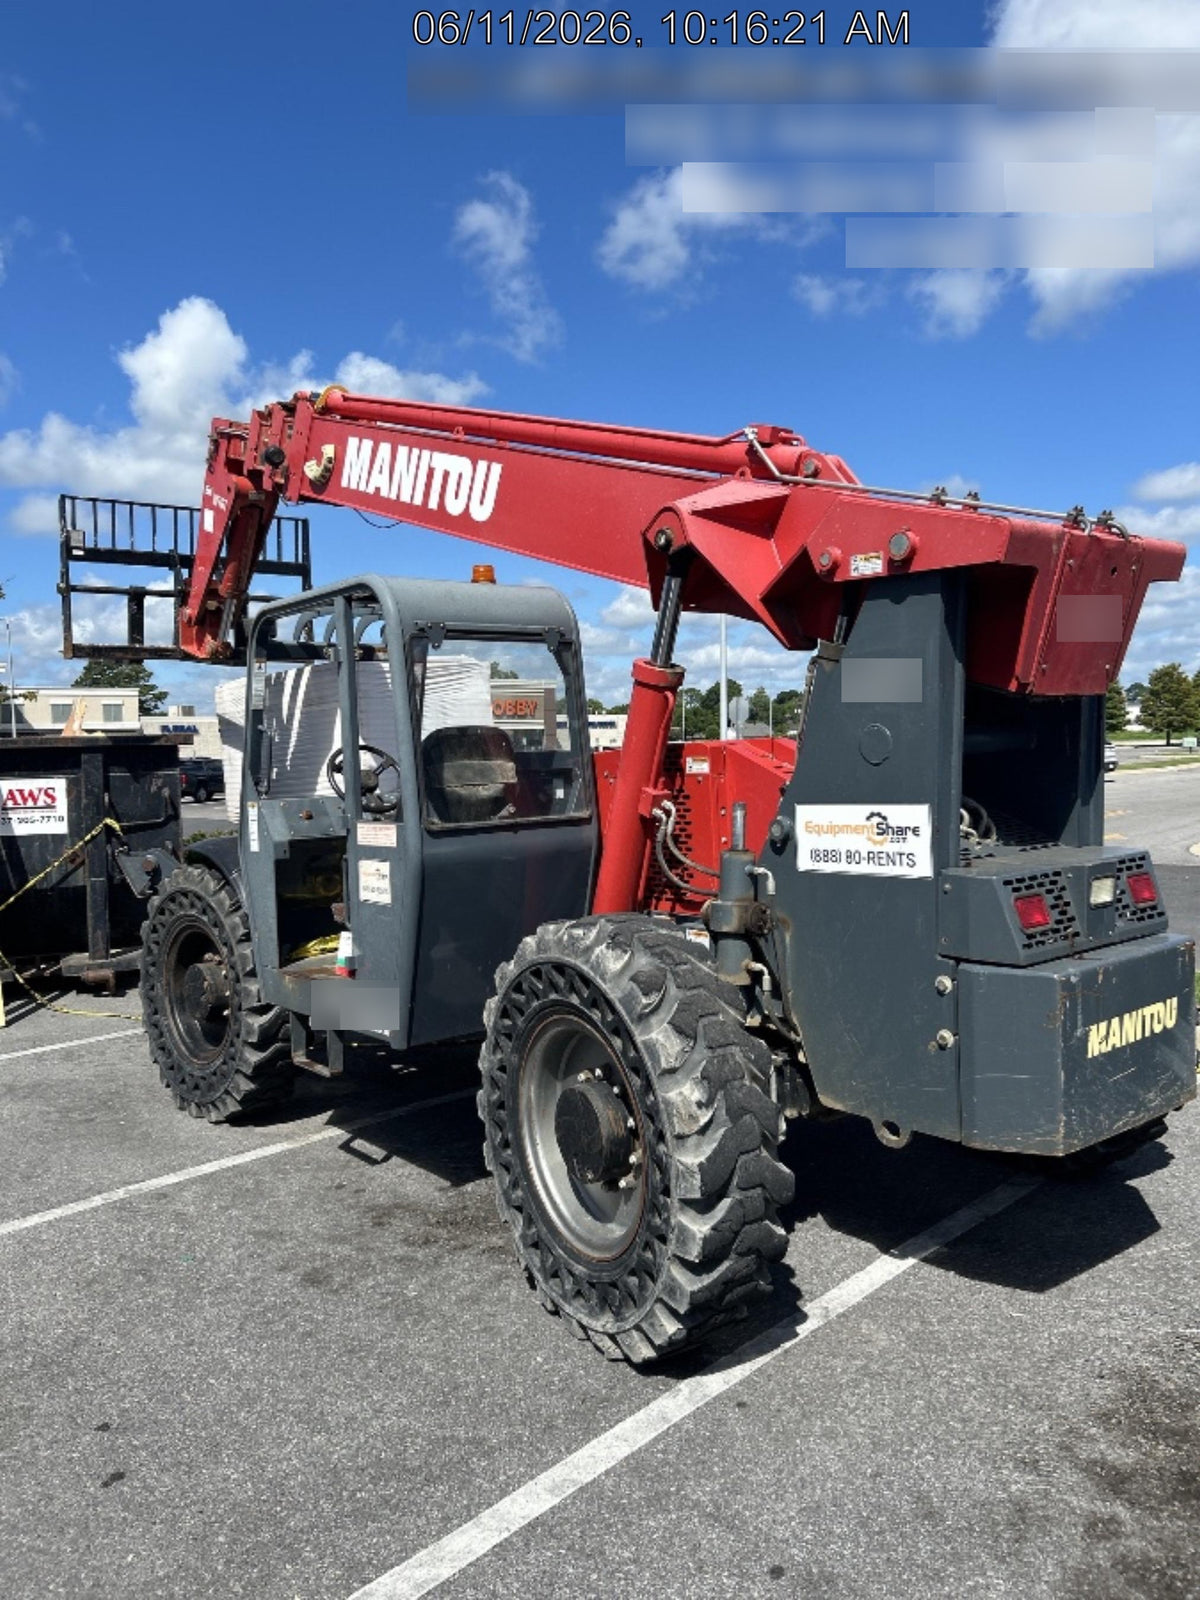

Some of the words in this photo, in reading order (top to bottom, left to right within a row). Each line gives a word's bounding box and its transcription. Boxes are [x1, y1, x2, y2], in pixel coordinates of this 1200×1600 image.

[341, 437, 503, 522] MANITOU
[490, 698, 538, 717] OBBY
[810, 848, 842, 864] (888)
[845, 849, 917, 868] 80-RENTS
[1087, 996, 1179, 1059] MANITOU
